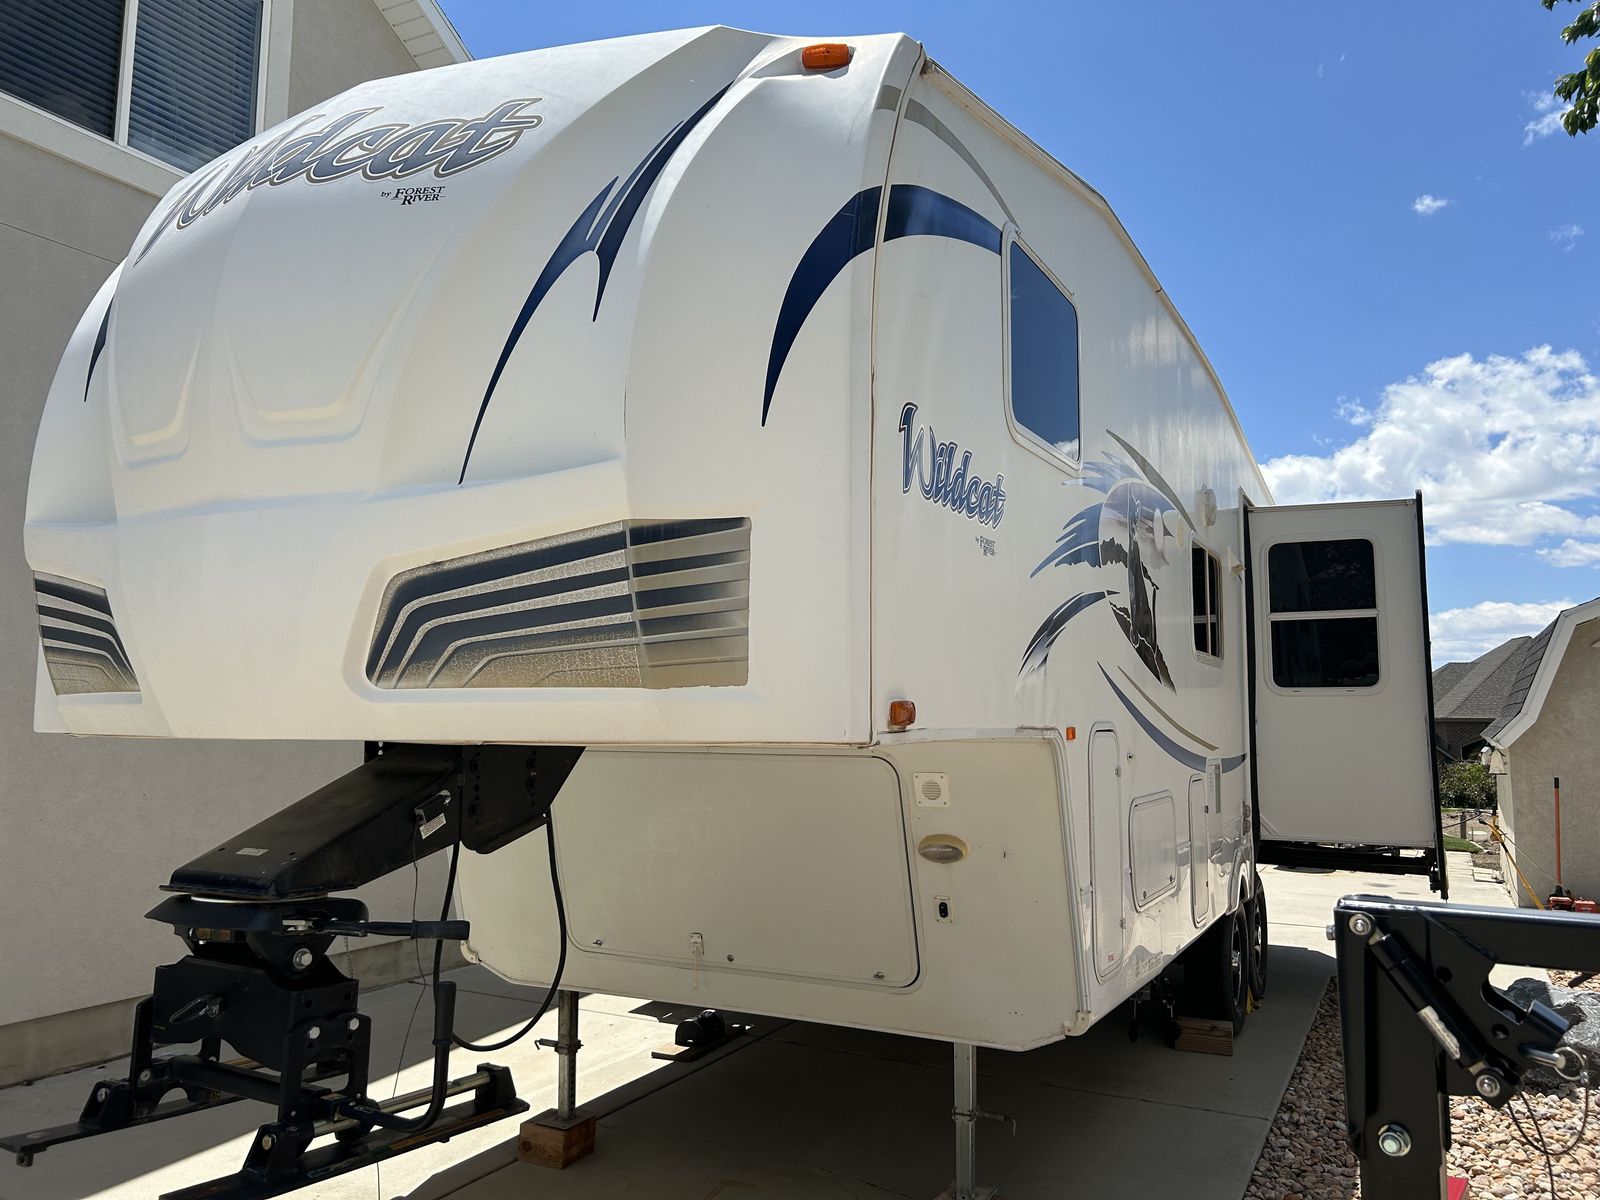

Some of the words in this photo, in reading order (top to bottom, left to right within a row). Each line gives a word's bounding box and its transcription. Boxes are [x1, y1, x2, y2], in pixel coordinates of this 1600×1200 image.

[133, 97, 544, 268] Wildcat
[393, 186, 446, 199] FOREST
[401, 193, 440, 206] RIVER
[898, 401, 1007, 530] Wildcat
